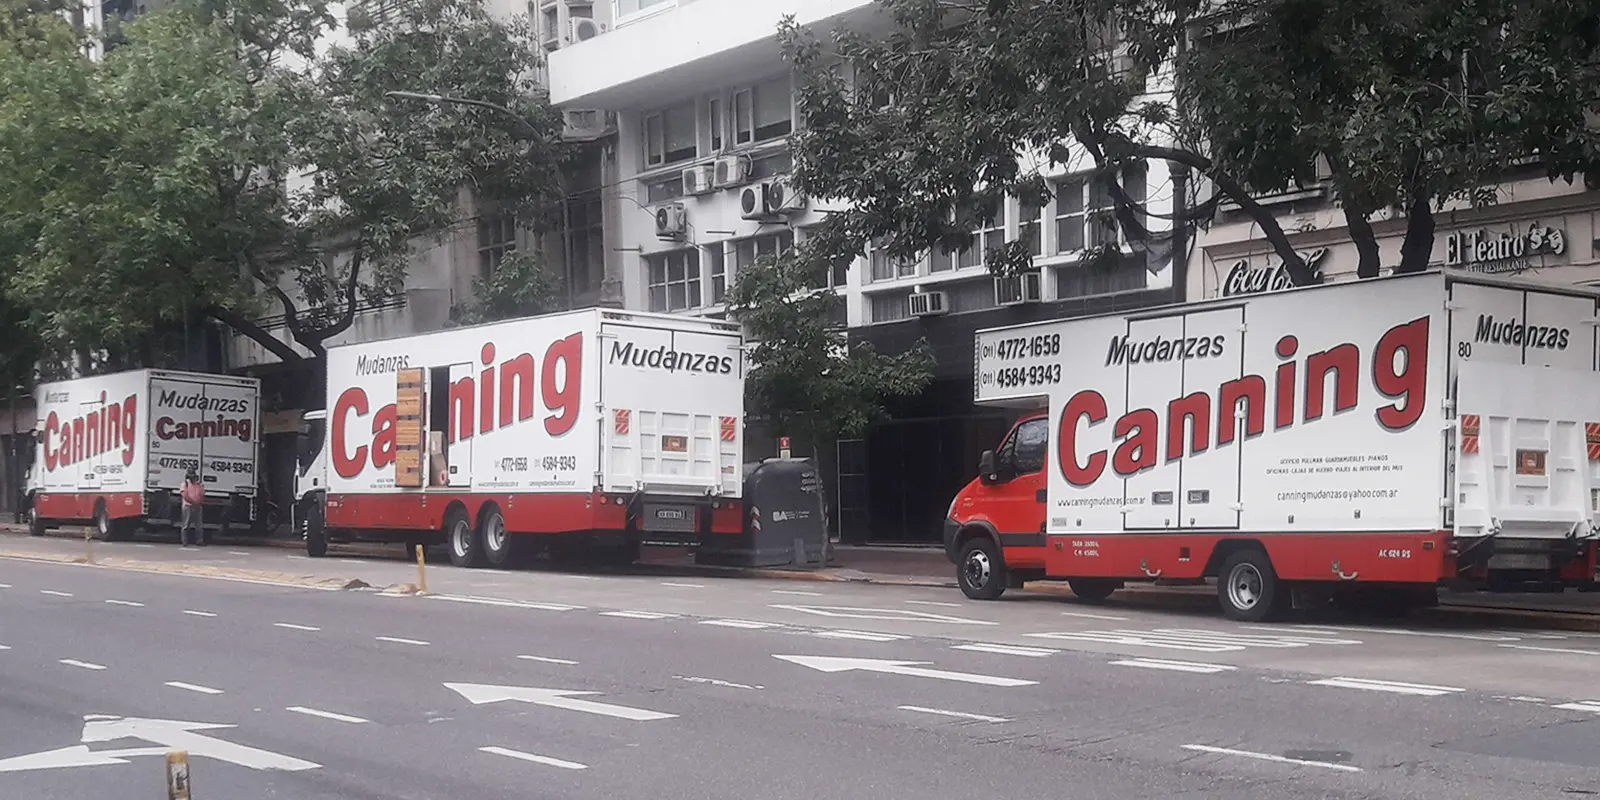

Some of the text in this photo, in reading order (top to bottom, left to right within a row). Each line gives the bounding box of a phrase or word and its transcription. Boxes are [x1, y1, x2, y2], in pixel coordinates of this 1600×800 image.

[1445, 230, 1524, 266] El Teatro
[1474, 314, 1569, 349] Mudanzas
[609, 341, 733, 374] Mudanzas
[980, 333, 1061, 361] (011) 4772-1658
[1105, 335, 1225, 367] Mudanzas
[1458, 341, 1472, 358] 80
[356, 353, 410, 377] Mudanzas
[980, 363, 1061, 388] (011) 4584-9343
[158, 389, 249, 414] Mudanzas
[1057, 314, 1430, 487] Canning
[43, 389, 137, 473] Canning
[156, 414, 252, 442] Canning
[159, 457, 253, 473] 4772-1658 4584-9343
[501, 457, 528, 471] 4772-1658
[542, 455, 576, 471] 4584-9343
[1021, 628, 1364, 652] BUS
